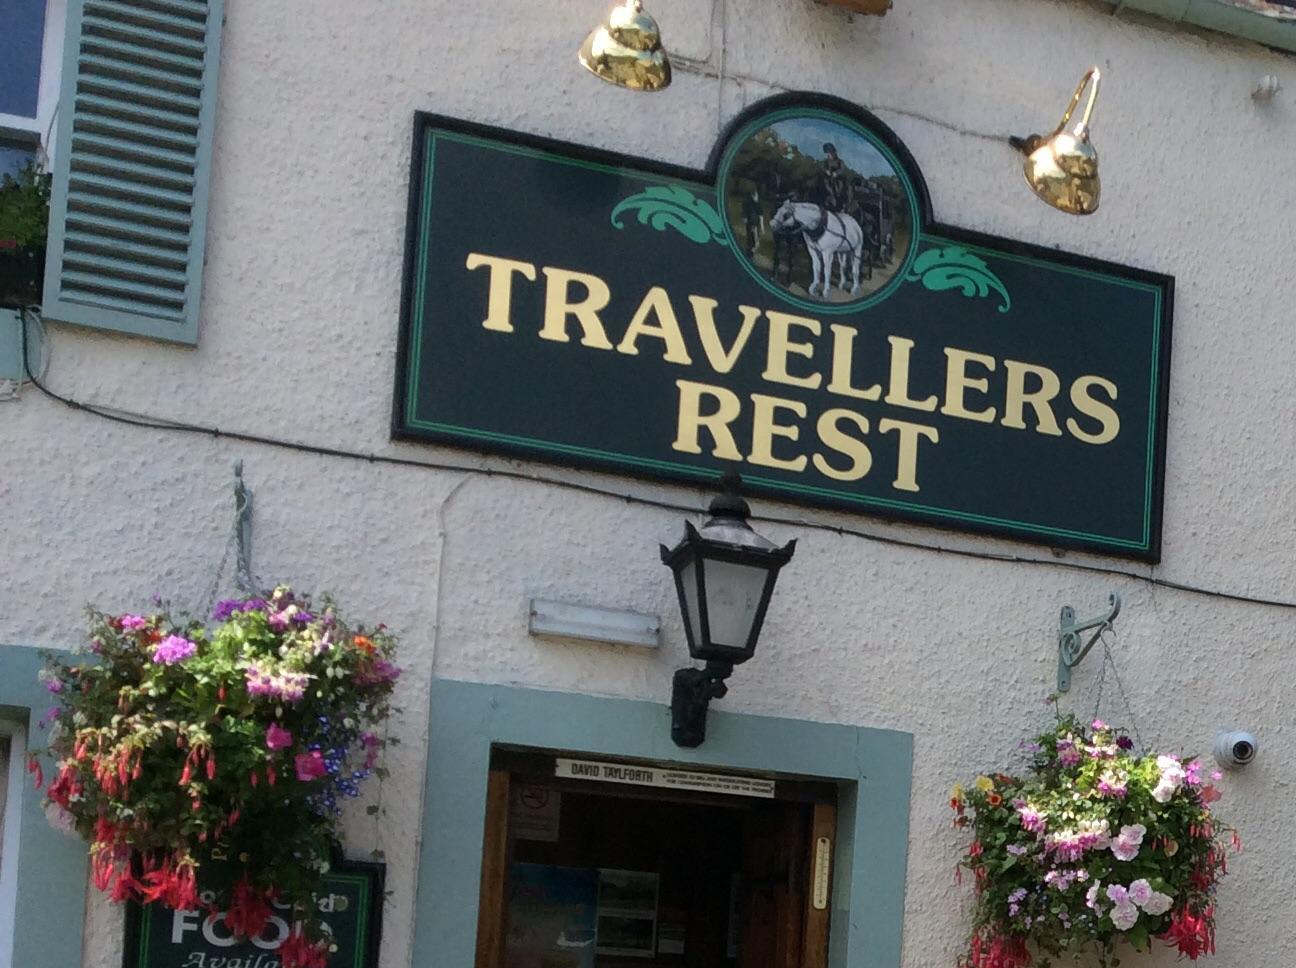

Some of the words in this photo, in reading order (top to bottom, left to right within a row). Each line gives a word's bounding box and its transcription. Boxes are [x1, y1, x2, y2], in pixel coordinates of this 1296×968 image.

[465, 252, 1121, 445] TRAVELLERS
[671, 378, 940, 492] REST
[571, 763, 600, 777] DAVID
[603, 766, 653, 782] TAYLFORTH
[171, 909, 335, 951] FOO
